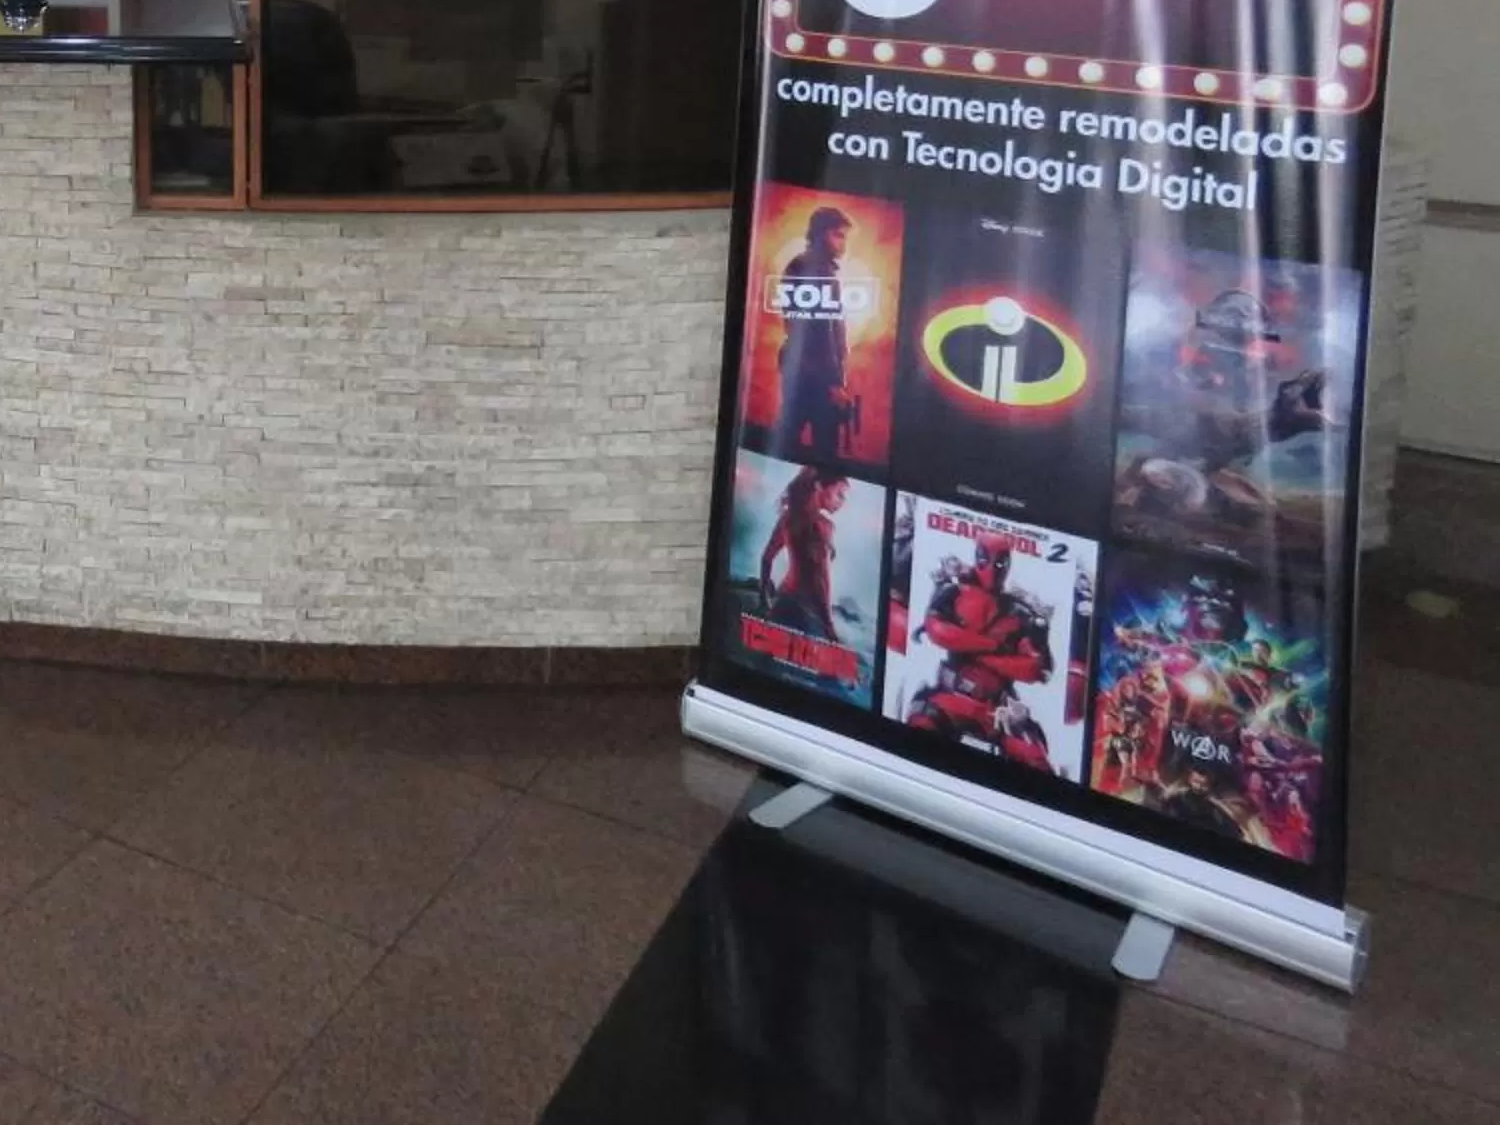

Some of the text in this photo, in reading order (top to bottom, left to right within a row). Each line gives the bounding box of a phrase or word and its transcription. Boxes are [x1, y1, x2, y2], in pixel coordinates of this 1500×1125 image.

[777, 76, 1347, 164] completamente remodeladas
[827, 131, 1257, 211] con Tecnologia Digital
[772, 283, 871, 309] SOLO
[1046, 543, 1069, 563] 2
